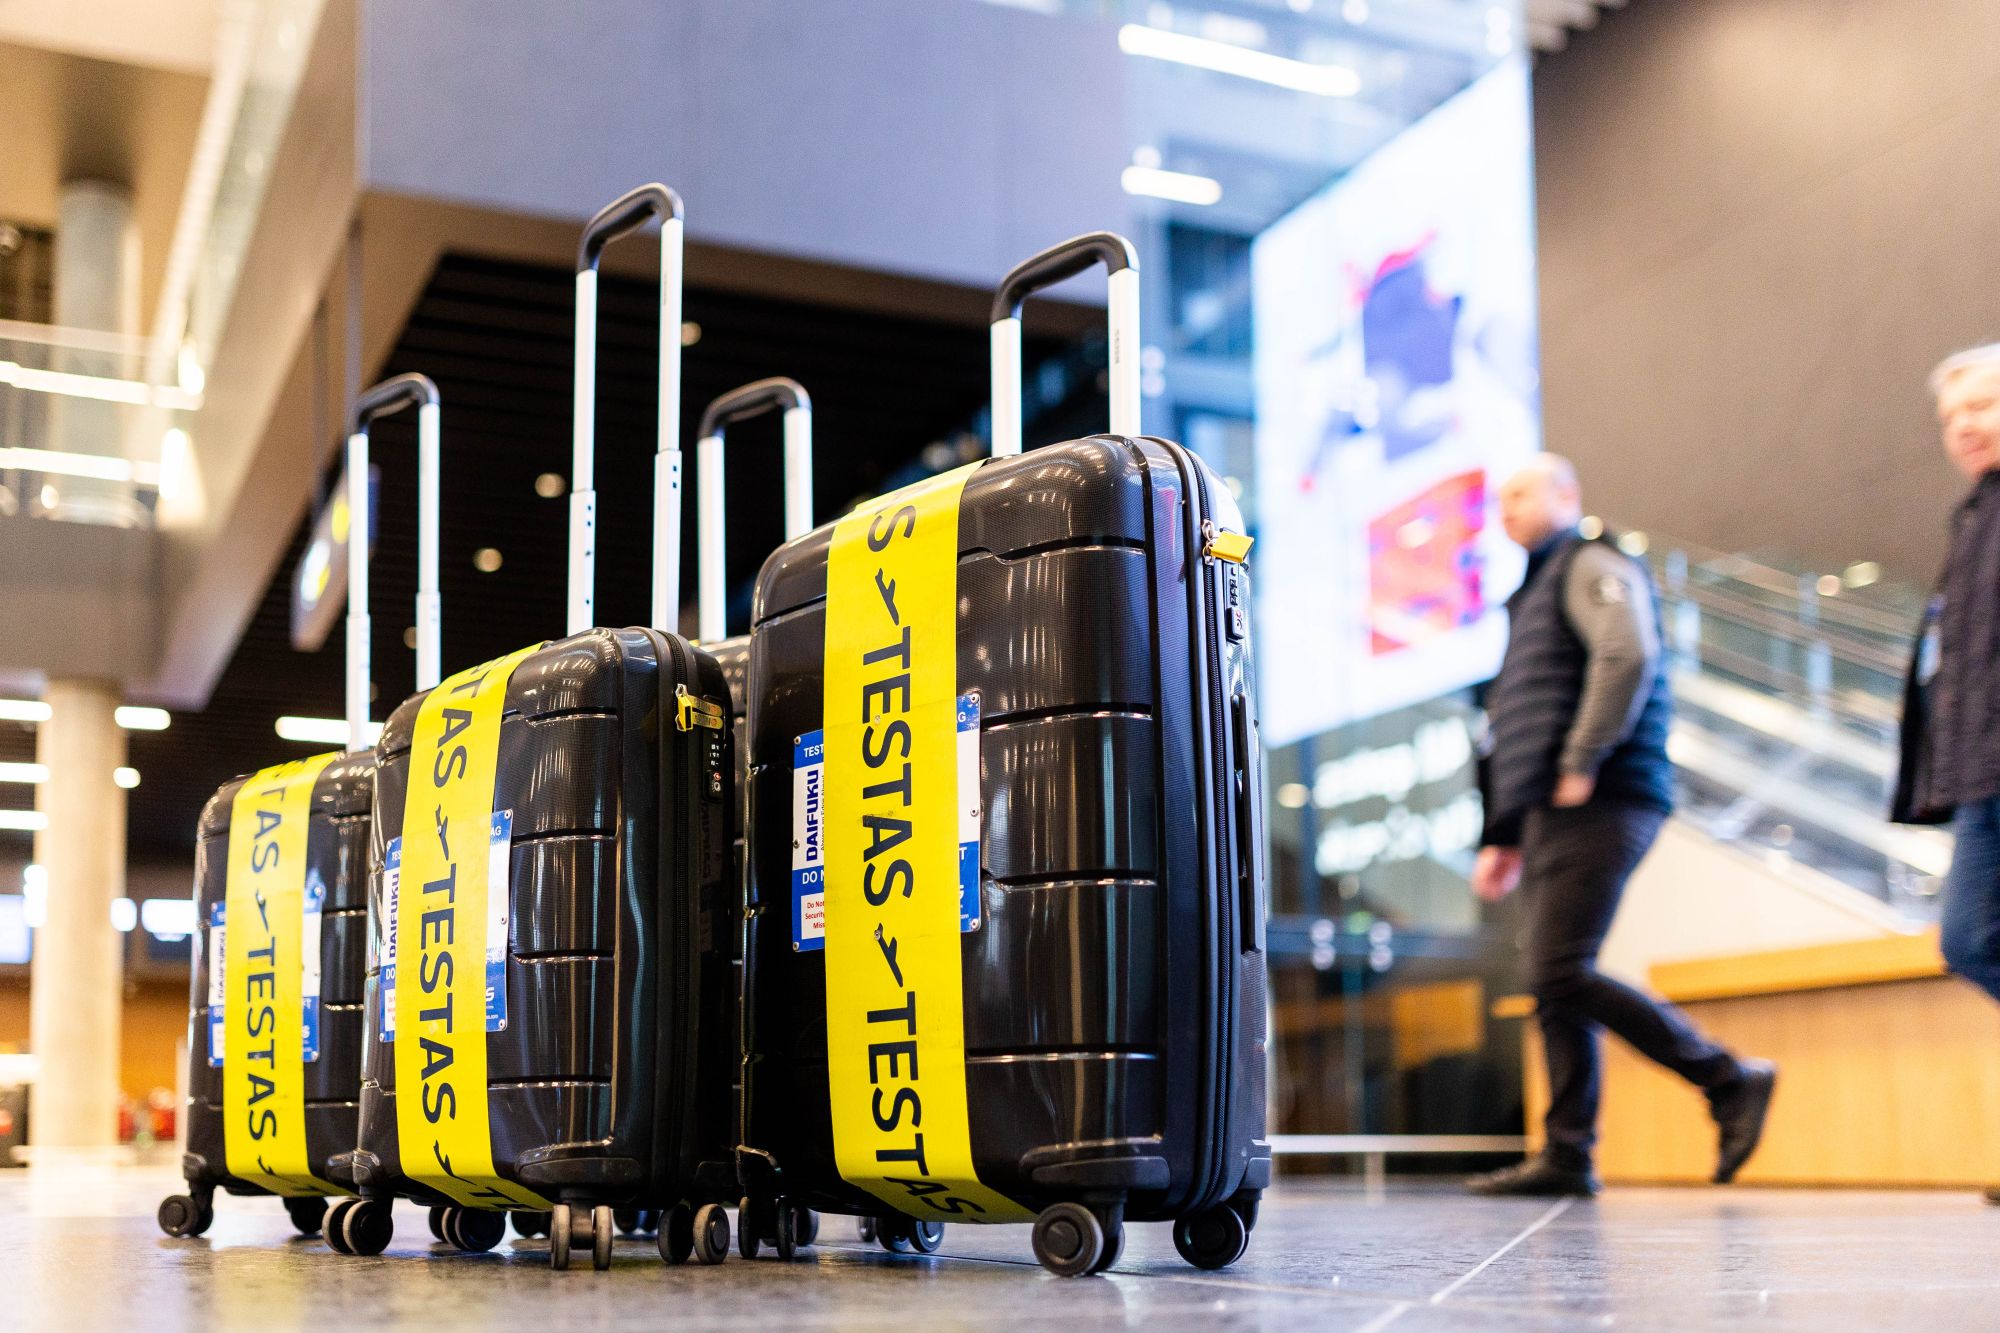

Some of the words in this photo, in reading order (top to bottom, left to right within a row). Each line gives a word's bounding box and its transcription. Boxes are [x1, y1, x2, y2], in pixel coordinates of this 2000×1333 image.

[806, 769, 819, 861] DAIFUKU
[862, 625, 914, 906] TESTAS
[389, 873, 399, 959] DAIFUKU
[802, 870, 818, 885] DO
[246, 936, 277, 1141] TESTAS
[419, 862, 456, 1124] TESTAS
[866, 991, 987, 1213] TESTAS
